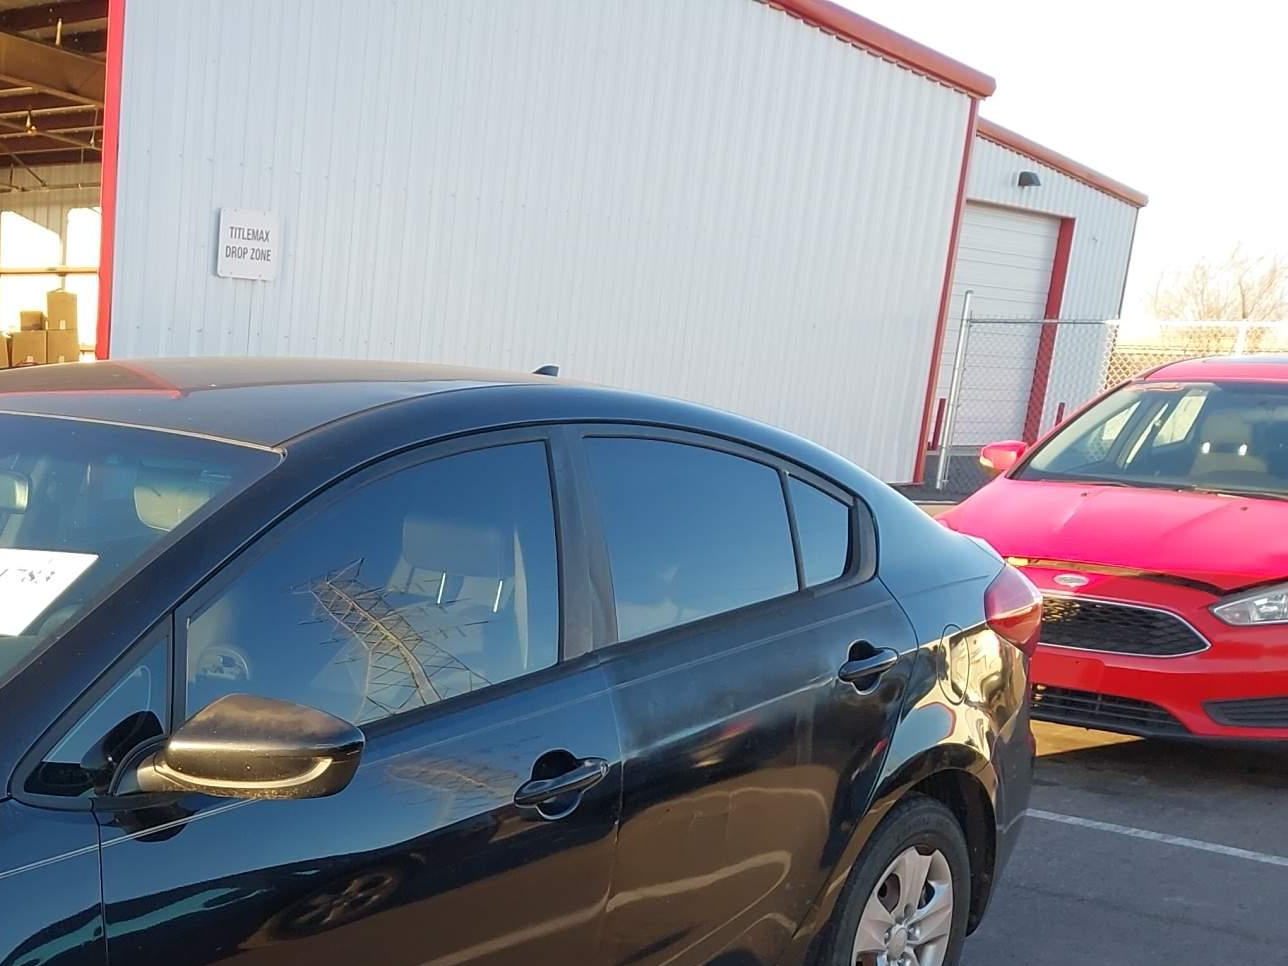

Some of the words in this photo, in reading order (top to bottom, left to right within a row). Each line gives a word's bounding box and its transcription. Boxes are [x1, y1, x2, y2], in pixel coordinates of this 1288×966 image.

[229, 226, 271, 243] TITLEMAX
[225, 245, 249, 260] DROP
[250, 247, 272, 262] ZONE
